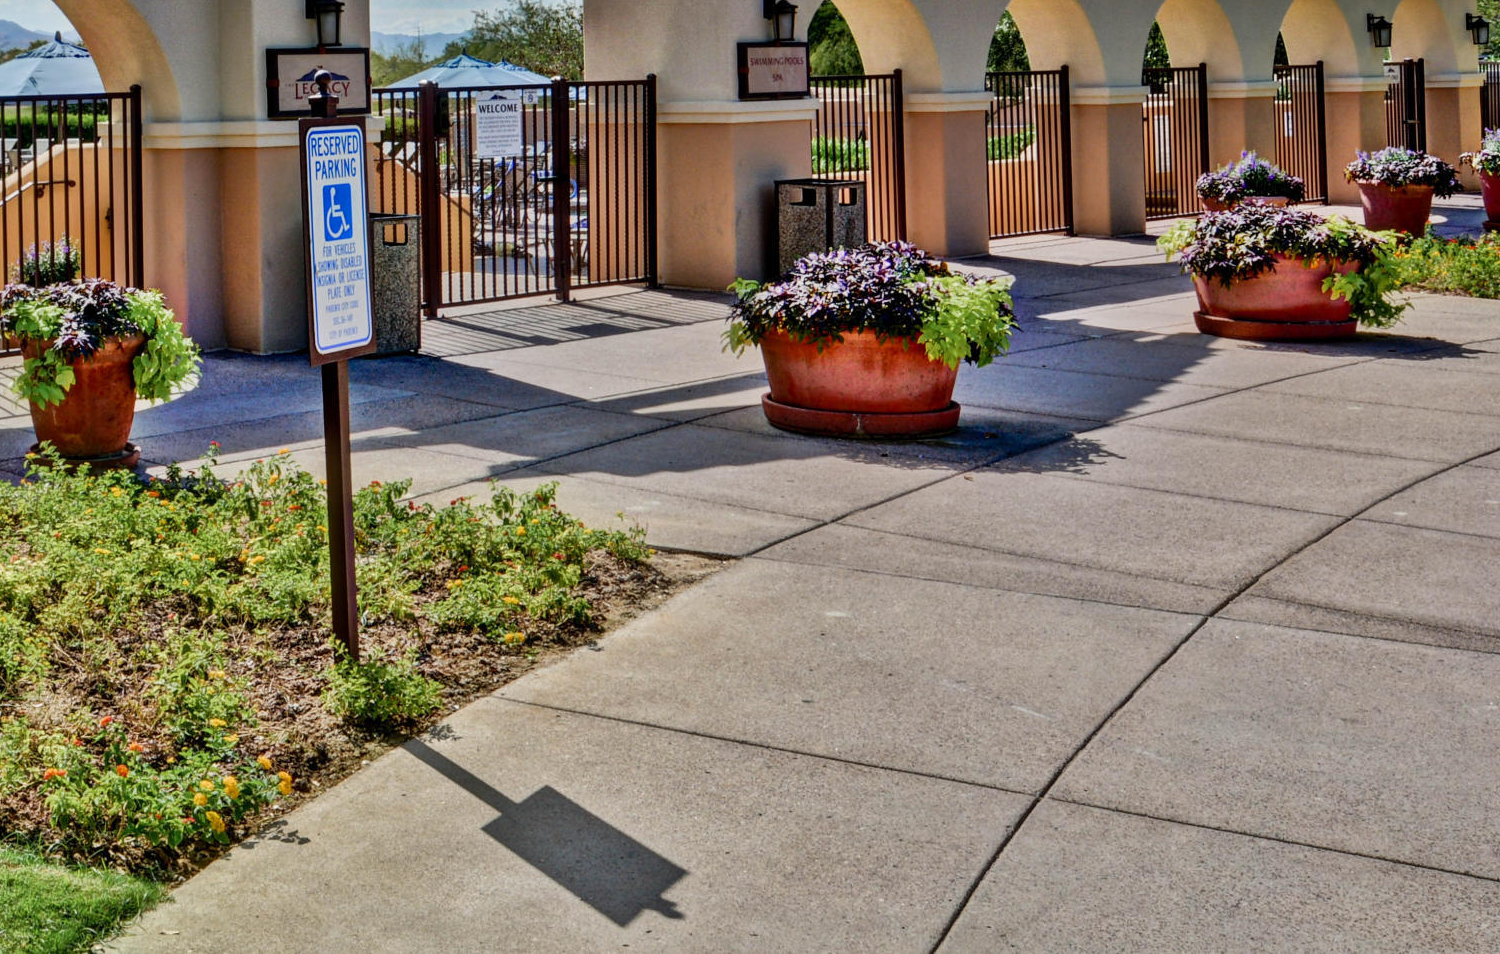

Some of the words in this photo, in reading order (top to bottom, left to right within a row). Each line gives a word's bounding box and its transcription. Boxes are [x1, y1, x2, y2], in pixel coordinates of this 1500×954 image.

[750, 57, 784, 66] SWIMMING
[784, 56, 804, 65] POOLS
[478, 103, 518, 114] WELCOME
[310, 134, 359, 157] RESERVED
[315, 157, 357, 180] PARKING
[323, 246, 332, 257] FOR
[334, 243, 356, 255] VEHICLES
[317, 259, 338, 272] SHOWING
[340, 255, 362, 269] DISABLED
[338, 272, 345, 283] OR
[347, 269, 364, 282] LICENSE
[327, 286, 341, 300] PLATE
[343, 285, 355, 297] ONLY
